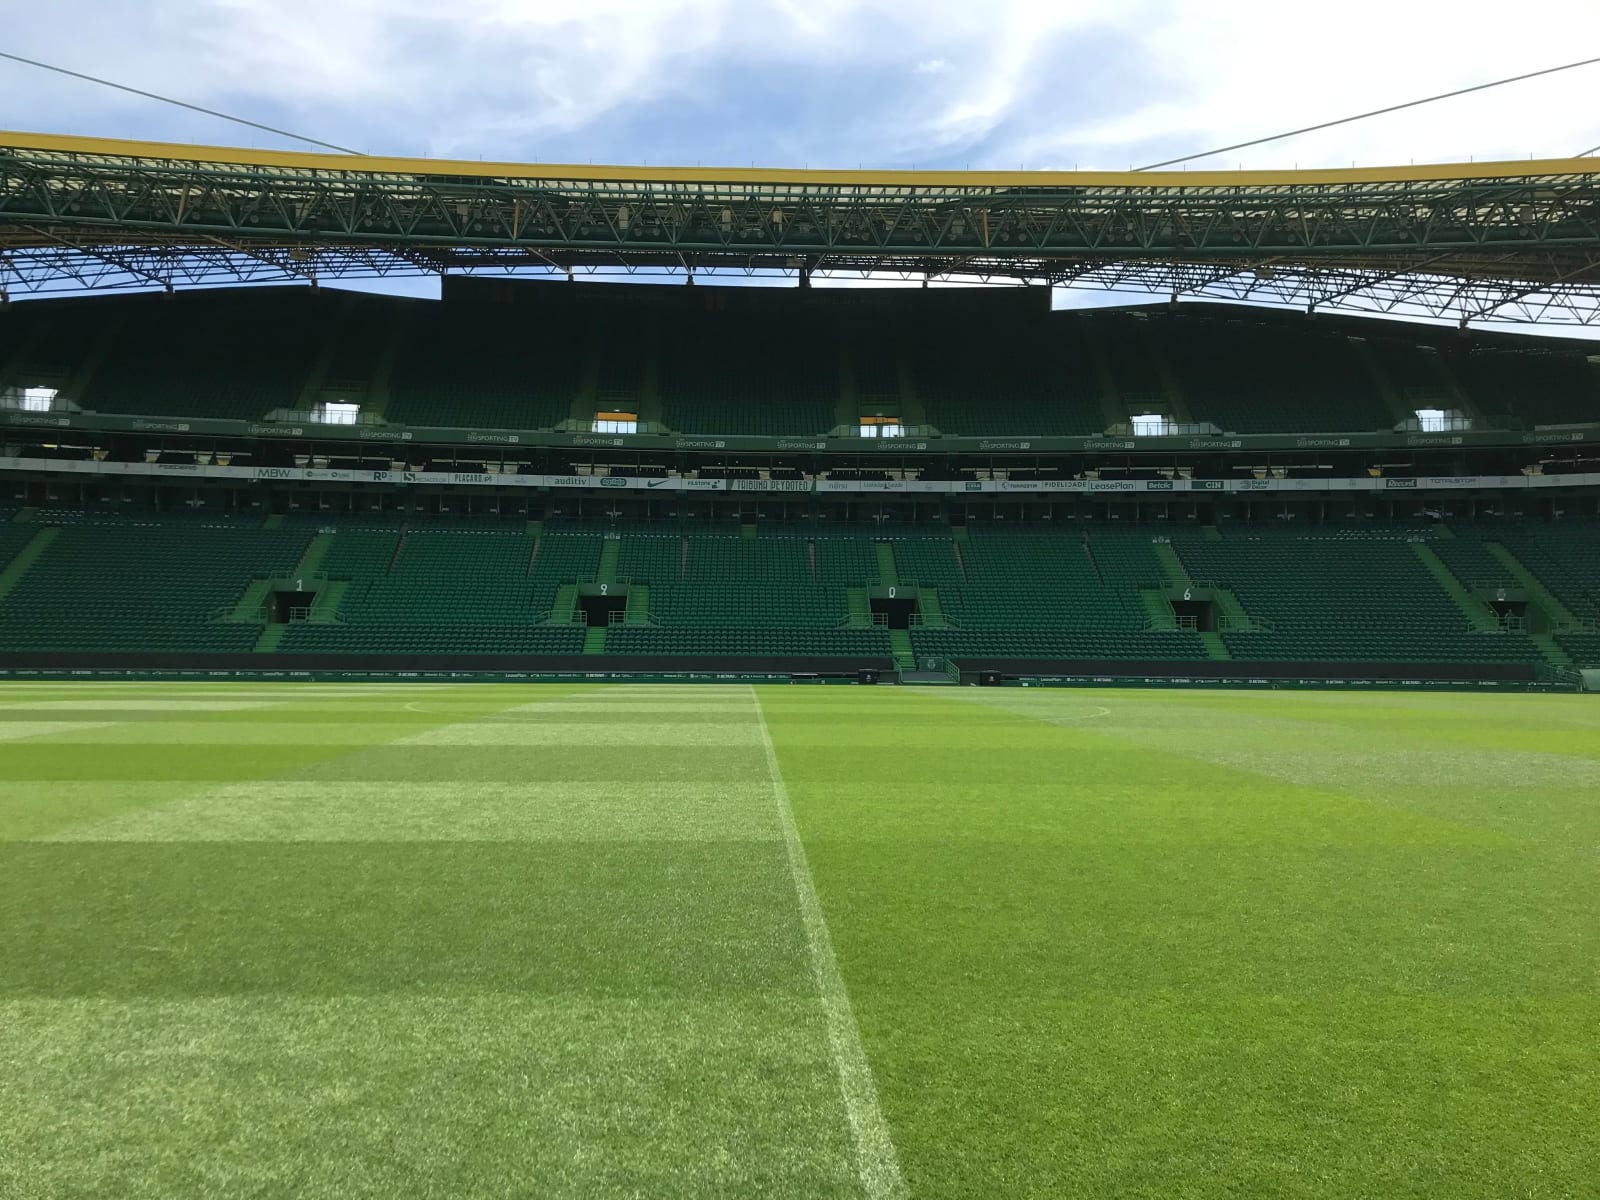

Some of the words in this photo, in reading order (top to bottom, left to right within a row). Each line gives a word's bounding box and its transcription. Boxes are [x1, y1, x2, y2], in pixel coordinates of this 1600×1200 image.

[258, 469, 291, 477] MBW
[554, 477, 587, 485] auditiv
[737, 480, 768, 490] TRIBUNA
[771, 481, 808, 491] PEYROTEO
[296, 579, 303, 591] 1
[600, 584, 608, 596] 9
[1183, 588, 1191, 600] 6
